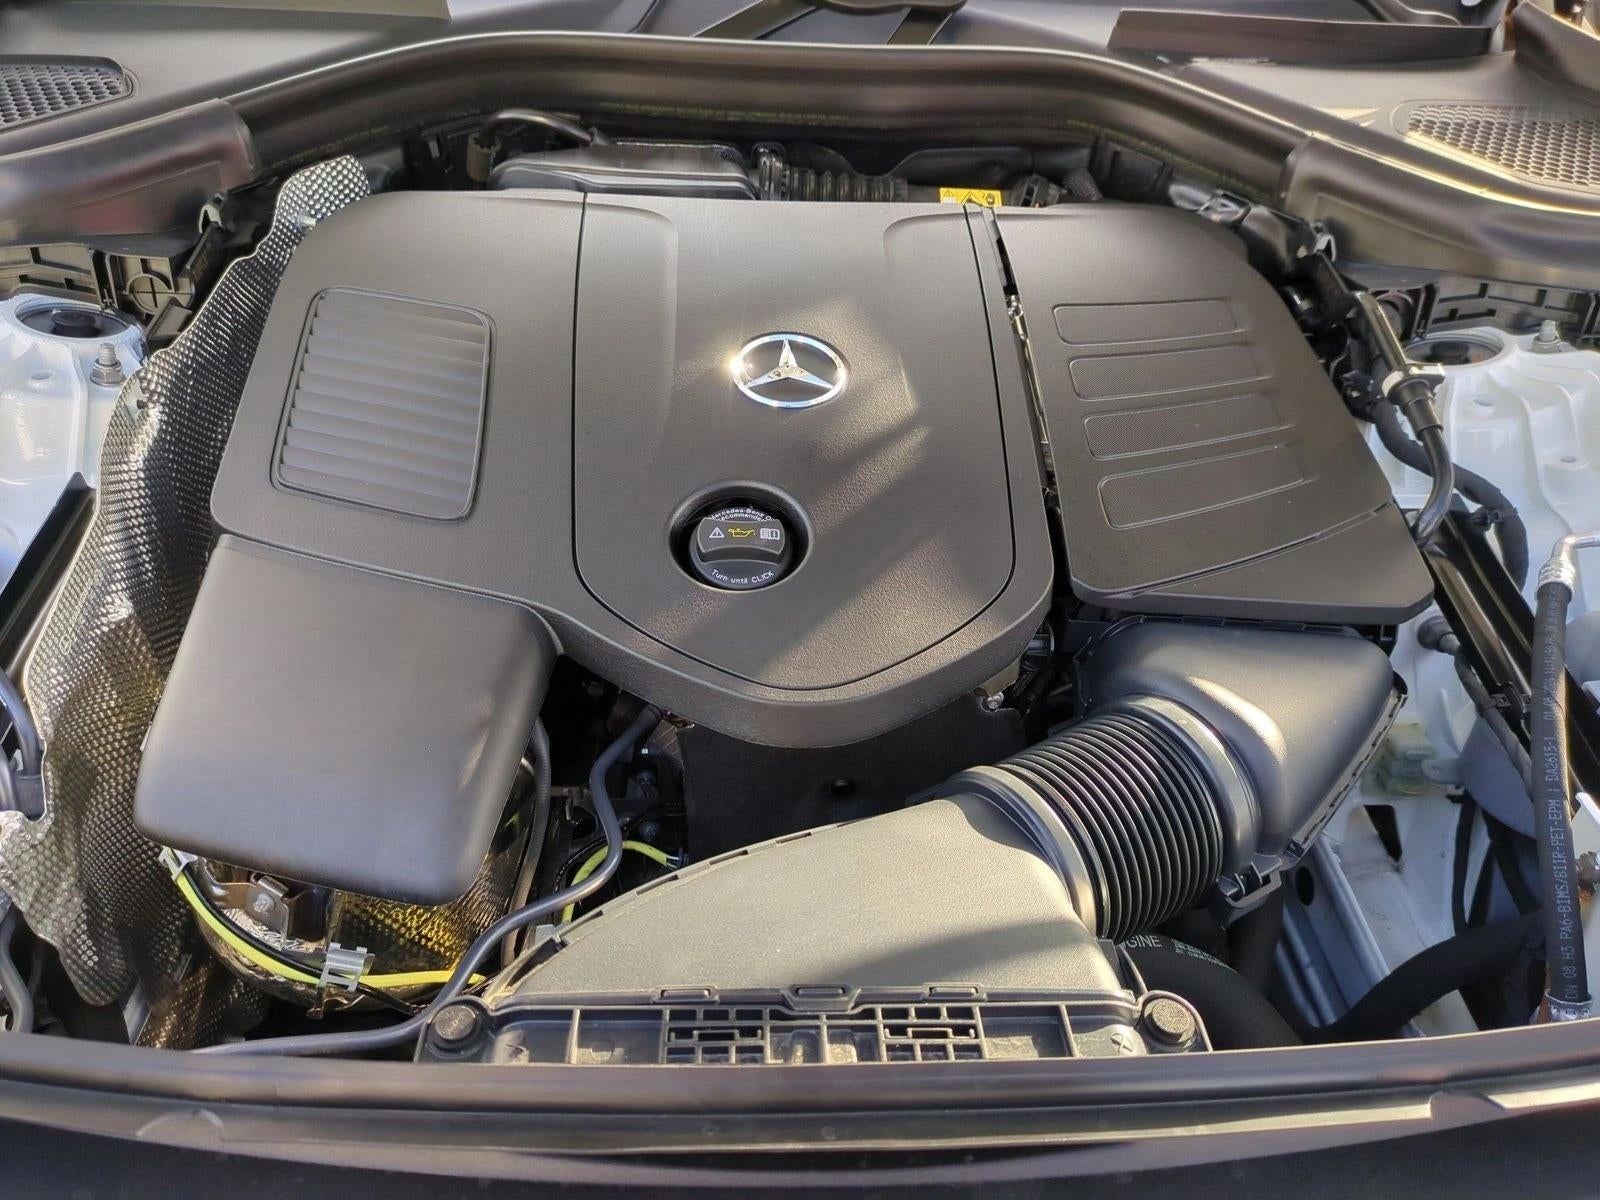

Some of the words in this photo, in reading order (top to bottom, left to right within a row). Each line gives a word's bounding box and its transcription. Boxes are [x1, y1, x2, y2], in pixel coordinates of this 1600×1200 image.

[711, 569, 728, 582] Turn
[730, 575, 748, 584] until
[751, 570, 775, 583] CLICK
